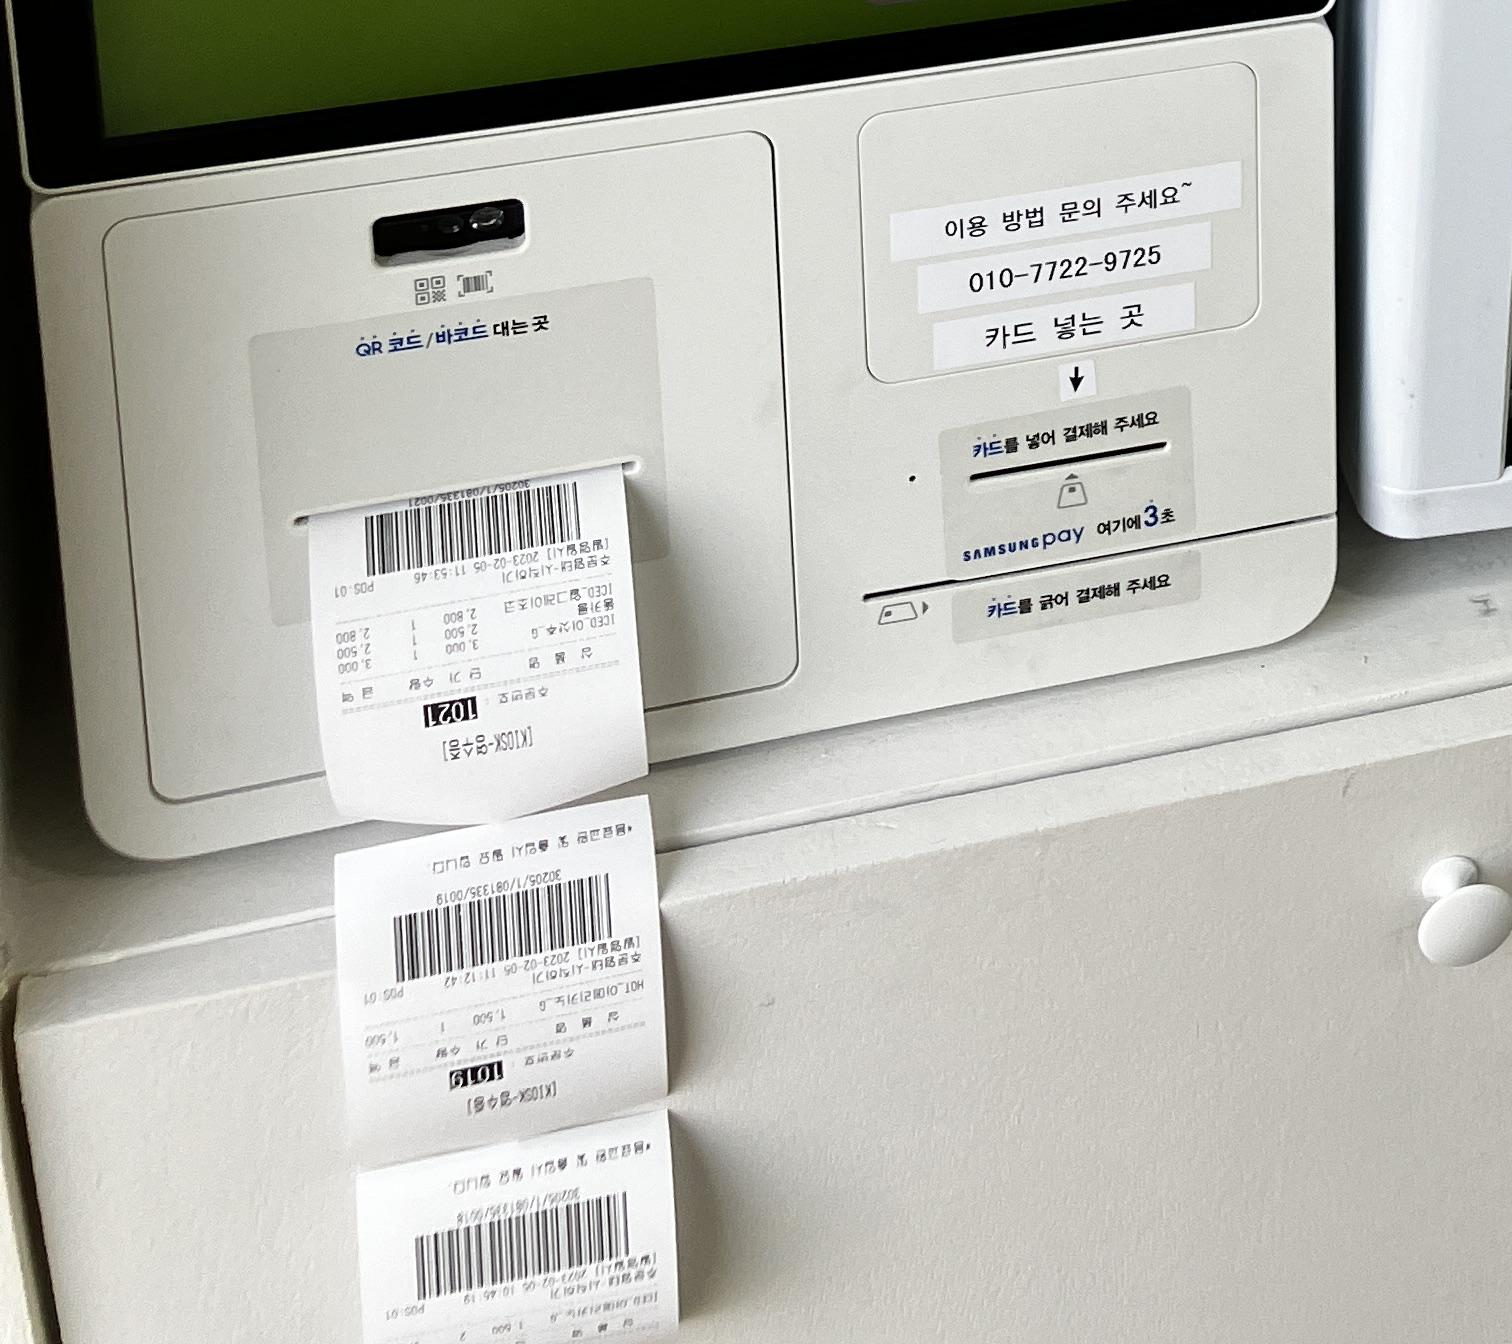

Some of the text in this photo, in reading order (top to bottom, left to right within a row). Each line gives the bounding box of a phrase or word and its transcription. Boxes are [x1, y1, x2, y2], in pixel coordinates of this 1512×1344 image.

[944, 181, 1192, 241] 이용 방법 문의 주세요~
[968, 244, 1162, 294] 010-7722-9725
[356, 339, 384, 358] QR
[491, 318, 528, 338] 대는
[531, 313, 550, 333] 곳
[985, 303, 1146, 350] 카드 넣는 곳
[972, 410, 1160, 460] 카드를 넣어 결제해 주세요
[413, 565, 467, 584] 11:53:46
[472, 551, 540, 573] 2023-02-05
[986, 573, 1172, 621] 카드를 긁어 결제해 주세요
[423, 697, 478, 728] 1021
